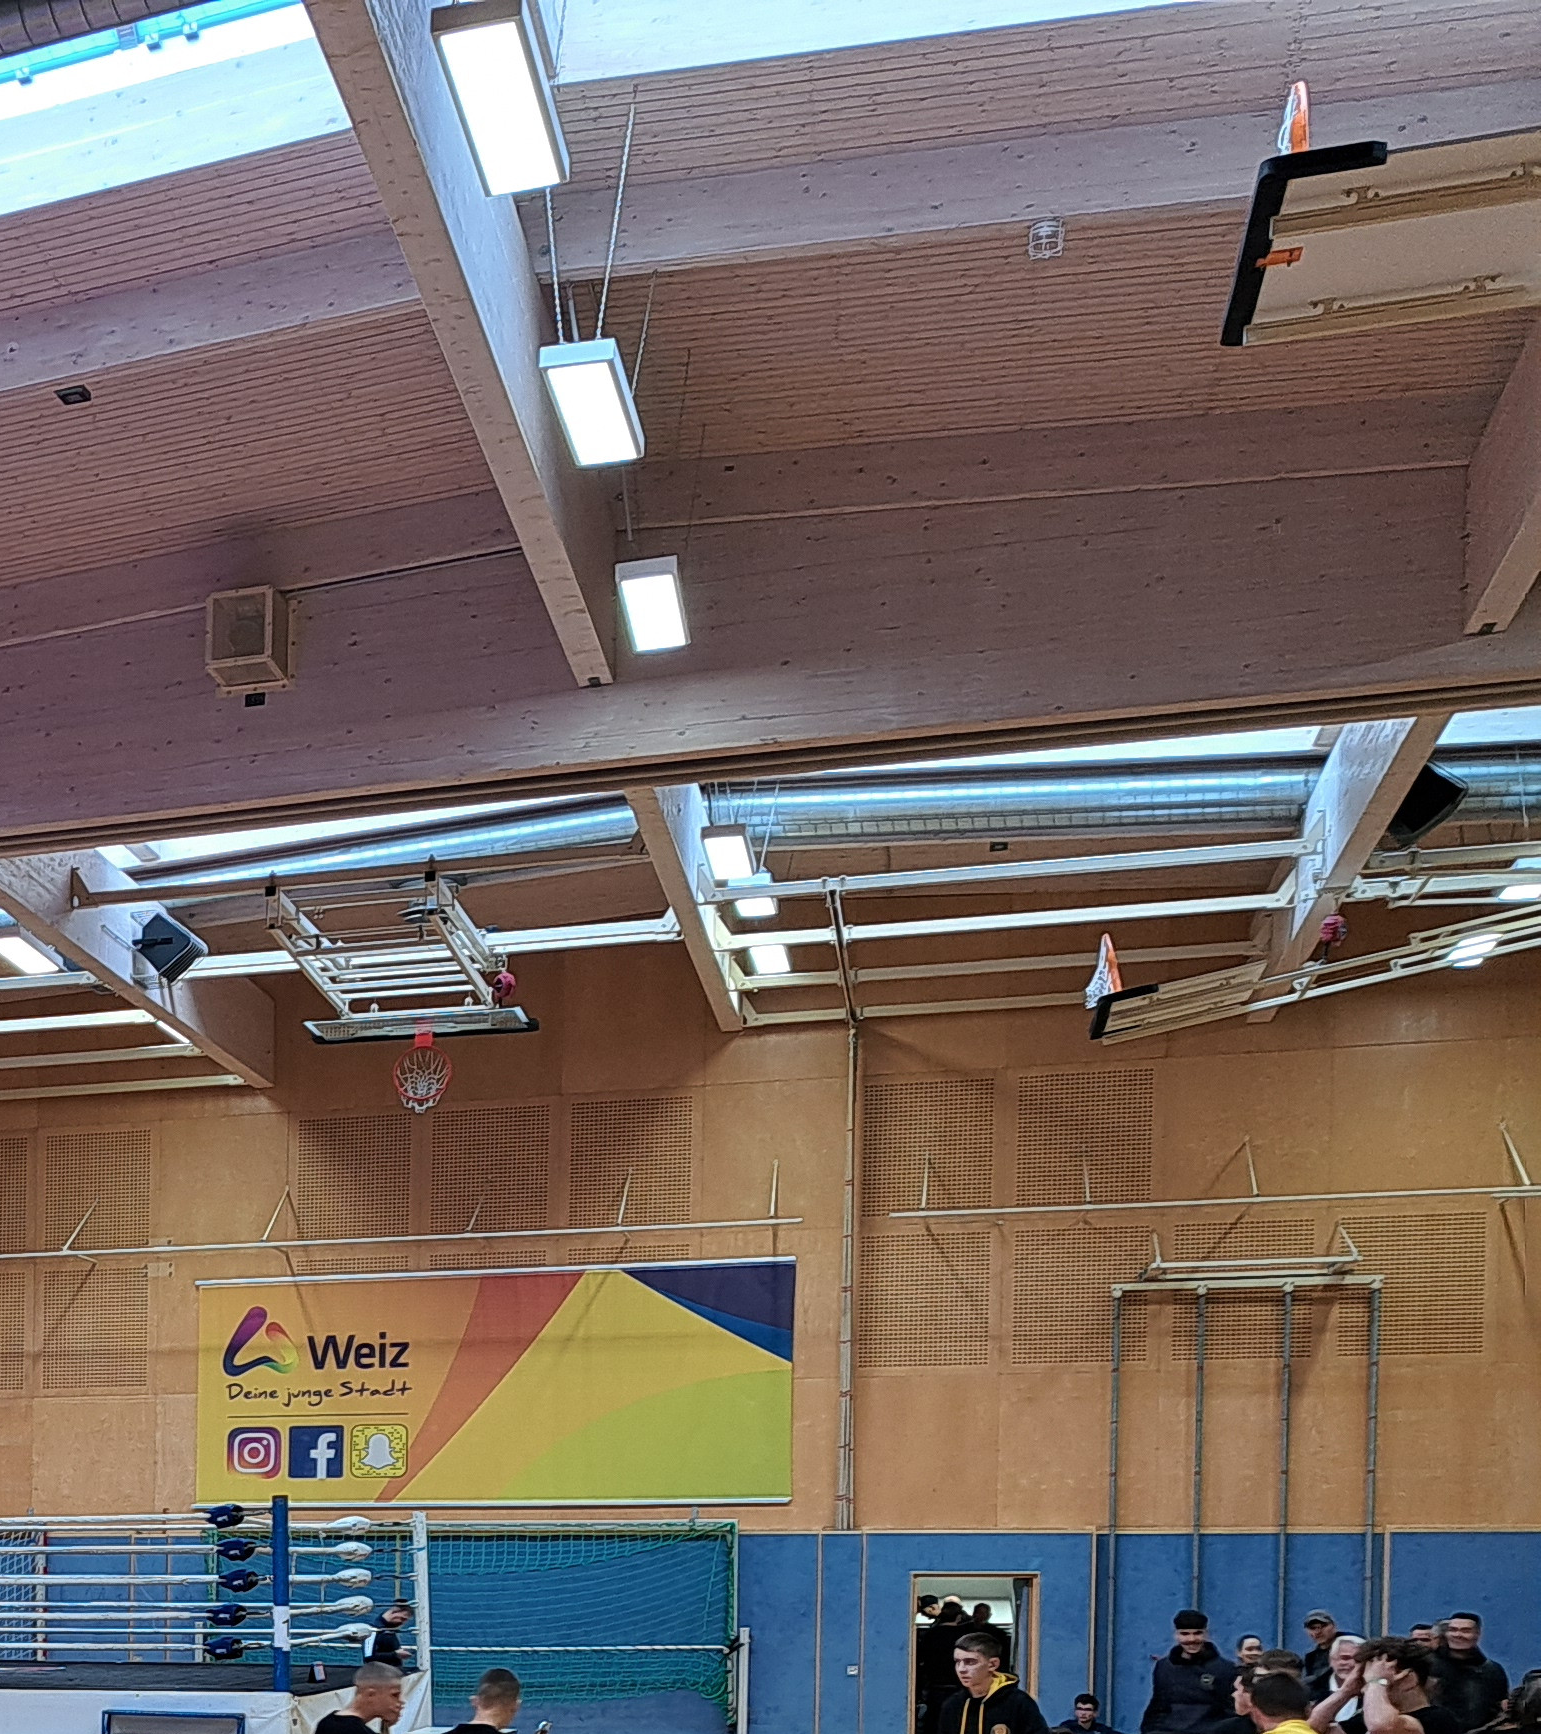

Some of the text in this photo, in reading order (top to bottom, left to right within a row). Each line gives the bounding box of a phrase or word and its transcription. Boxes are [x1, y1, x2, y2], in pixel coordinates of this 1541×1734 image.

[306, 1331, 411, 1371] Weiz
[225, 1378, 414, 1408] Deine junge Stadt
